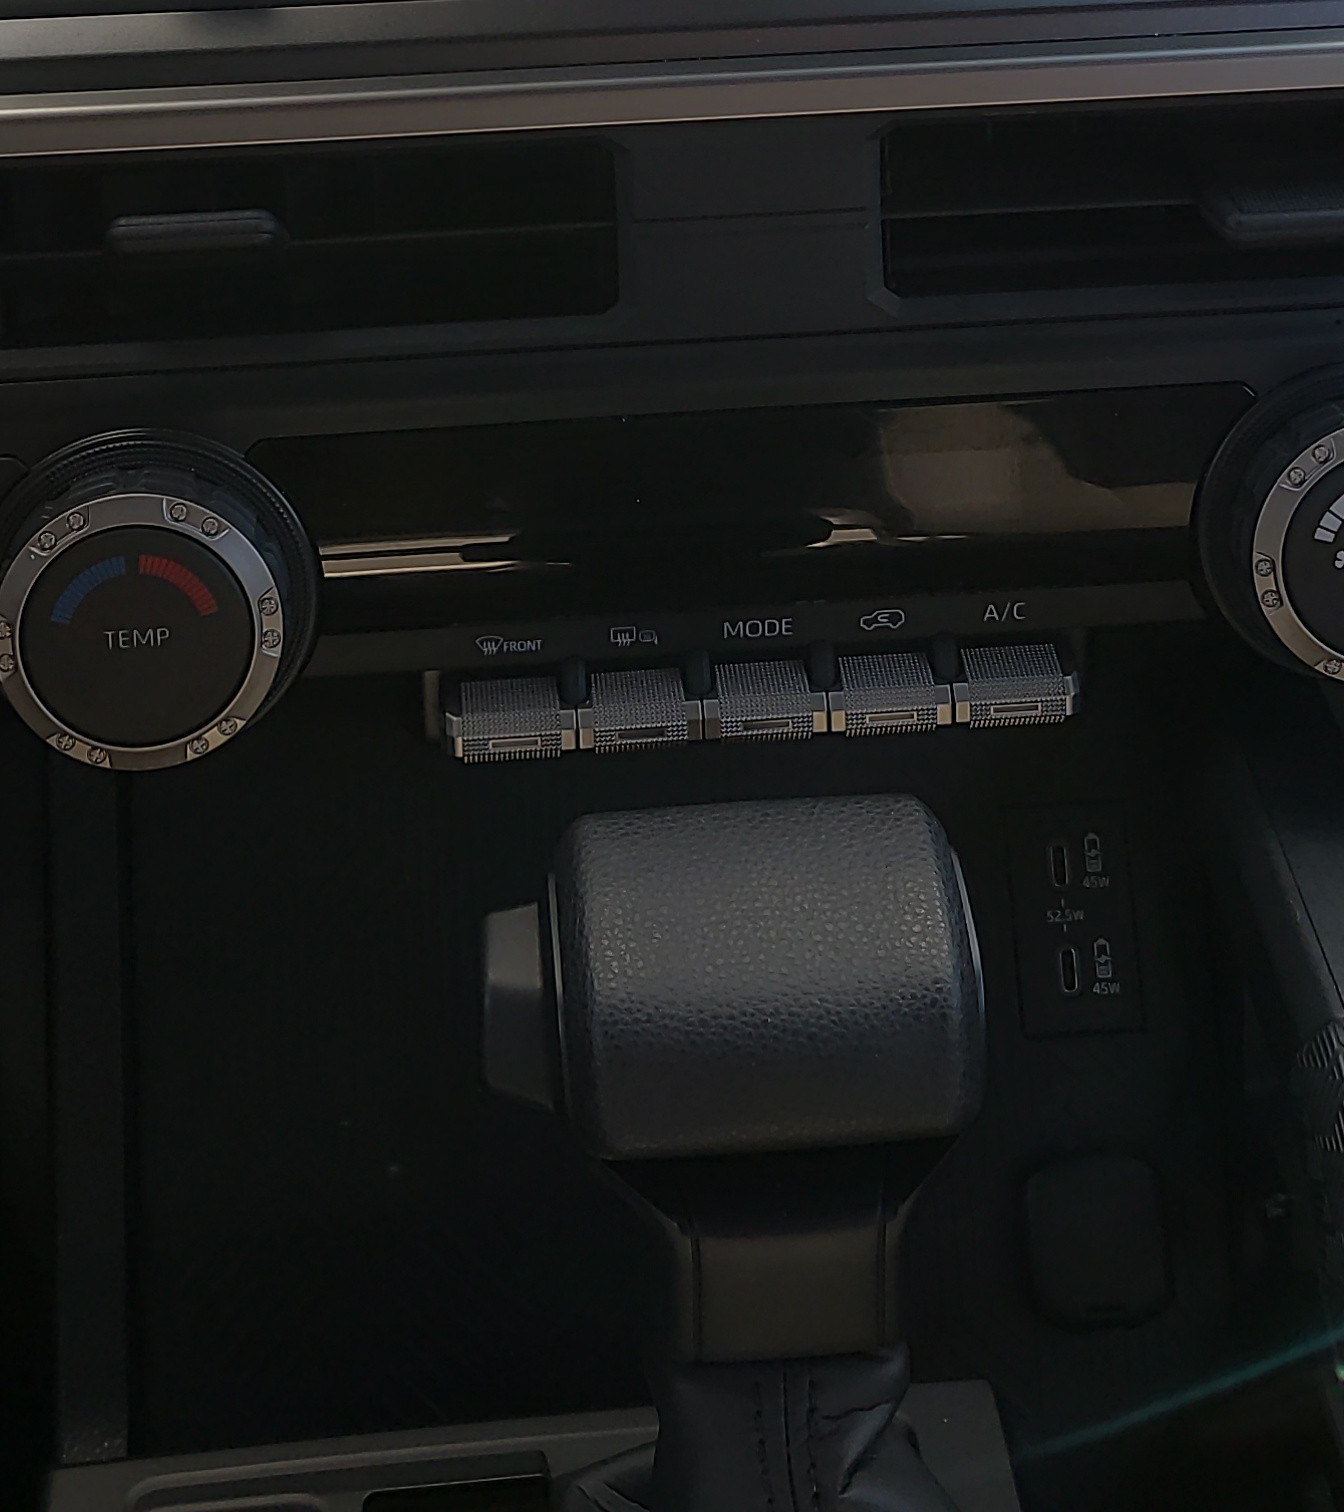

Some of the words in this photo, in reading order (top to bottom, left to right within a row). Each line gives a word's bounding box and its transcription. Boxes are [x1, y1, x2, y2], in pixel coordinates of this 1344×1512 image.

[982, 602, 1026, 623] A/C
[103, 627, 171, 650] TEMP
[722, 617, 794, 639] MODE
[502, 638, 543, 654] FRONT
[1092, 981, 1120, 995] 45W
